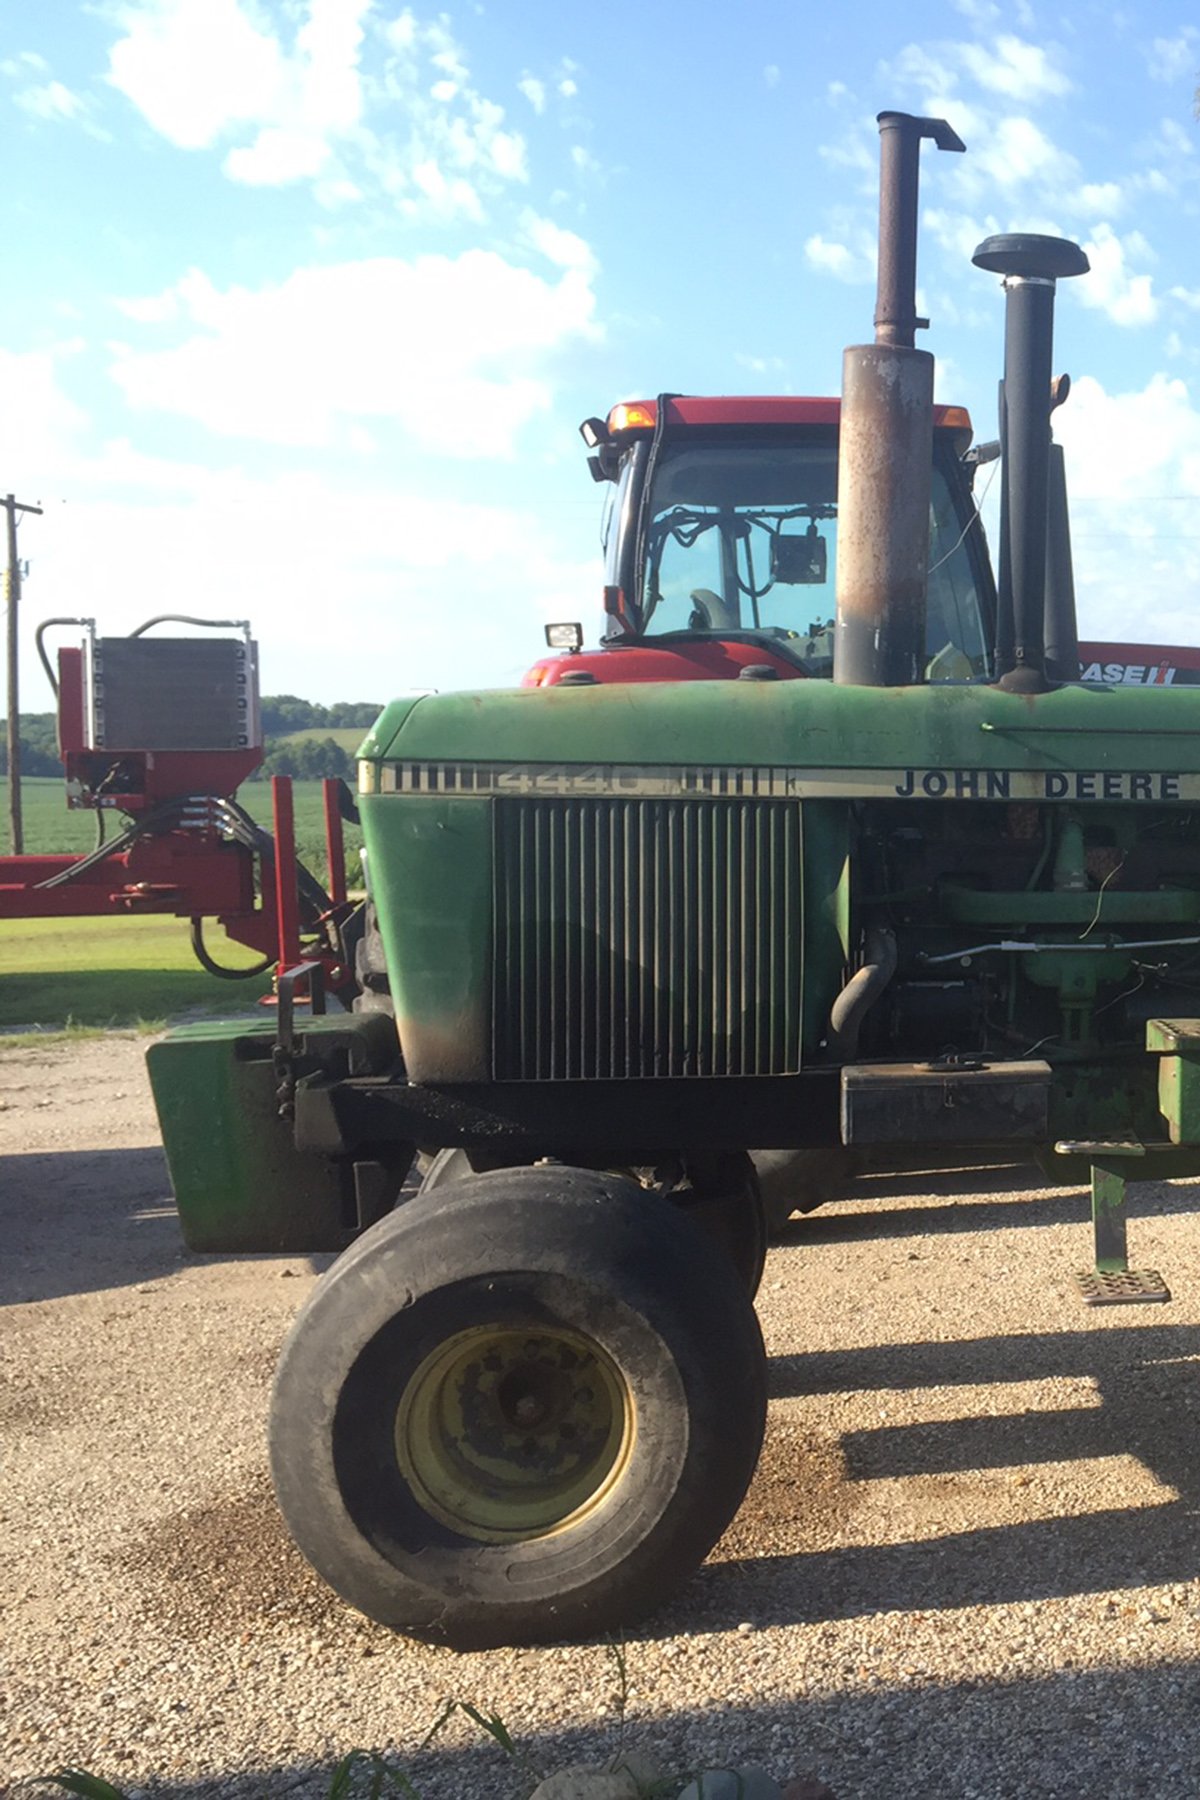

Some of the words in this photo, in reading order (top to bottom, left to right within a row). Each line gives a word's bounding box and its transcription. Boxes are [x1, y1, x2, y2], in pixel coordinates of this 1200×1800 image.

[1078, 662, 1147, 684] ASE
[497, 765, 642, 794] 4440
[895, 770, 1011, 798] JOHN
[1045, 773, 1181, 800] DEERE
